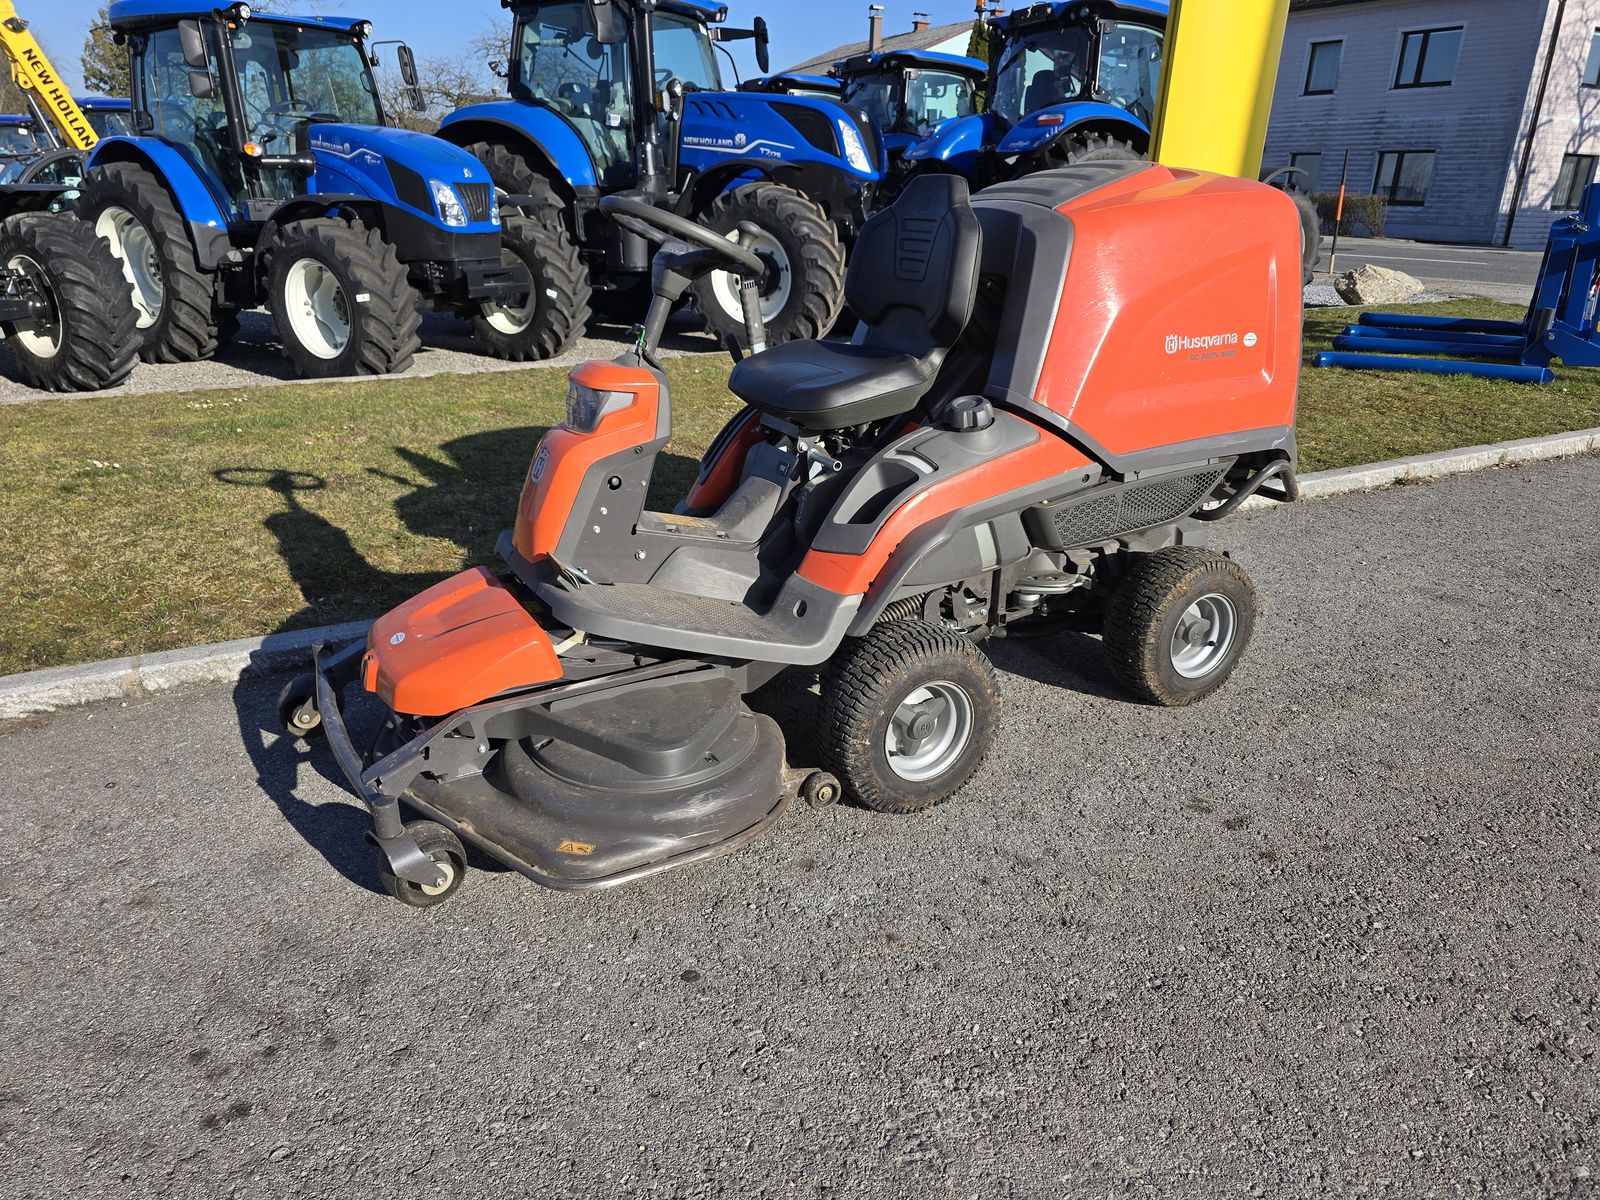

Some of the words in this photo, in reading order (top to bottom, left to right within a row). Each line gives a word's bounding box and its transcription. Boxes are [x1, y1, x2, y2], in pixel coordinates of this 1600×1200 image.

[22, 48, 54, 85] NEW
[683, 136, 699, 144] NEW
[699, 137, 733, 147] HOLLAND
[1178, 332, 1238, 350] Husqvarna
